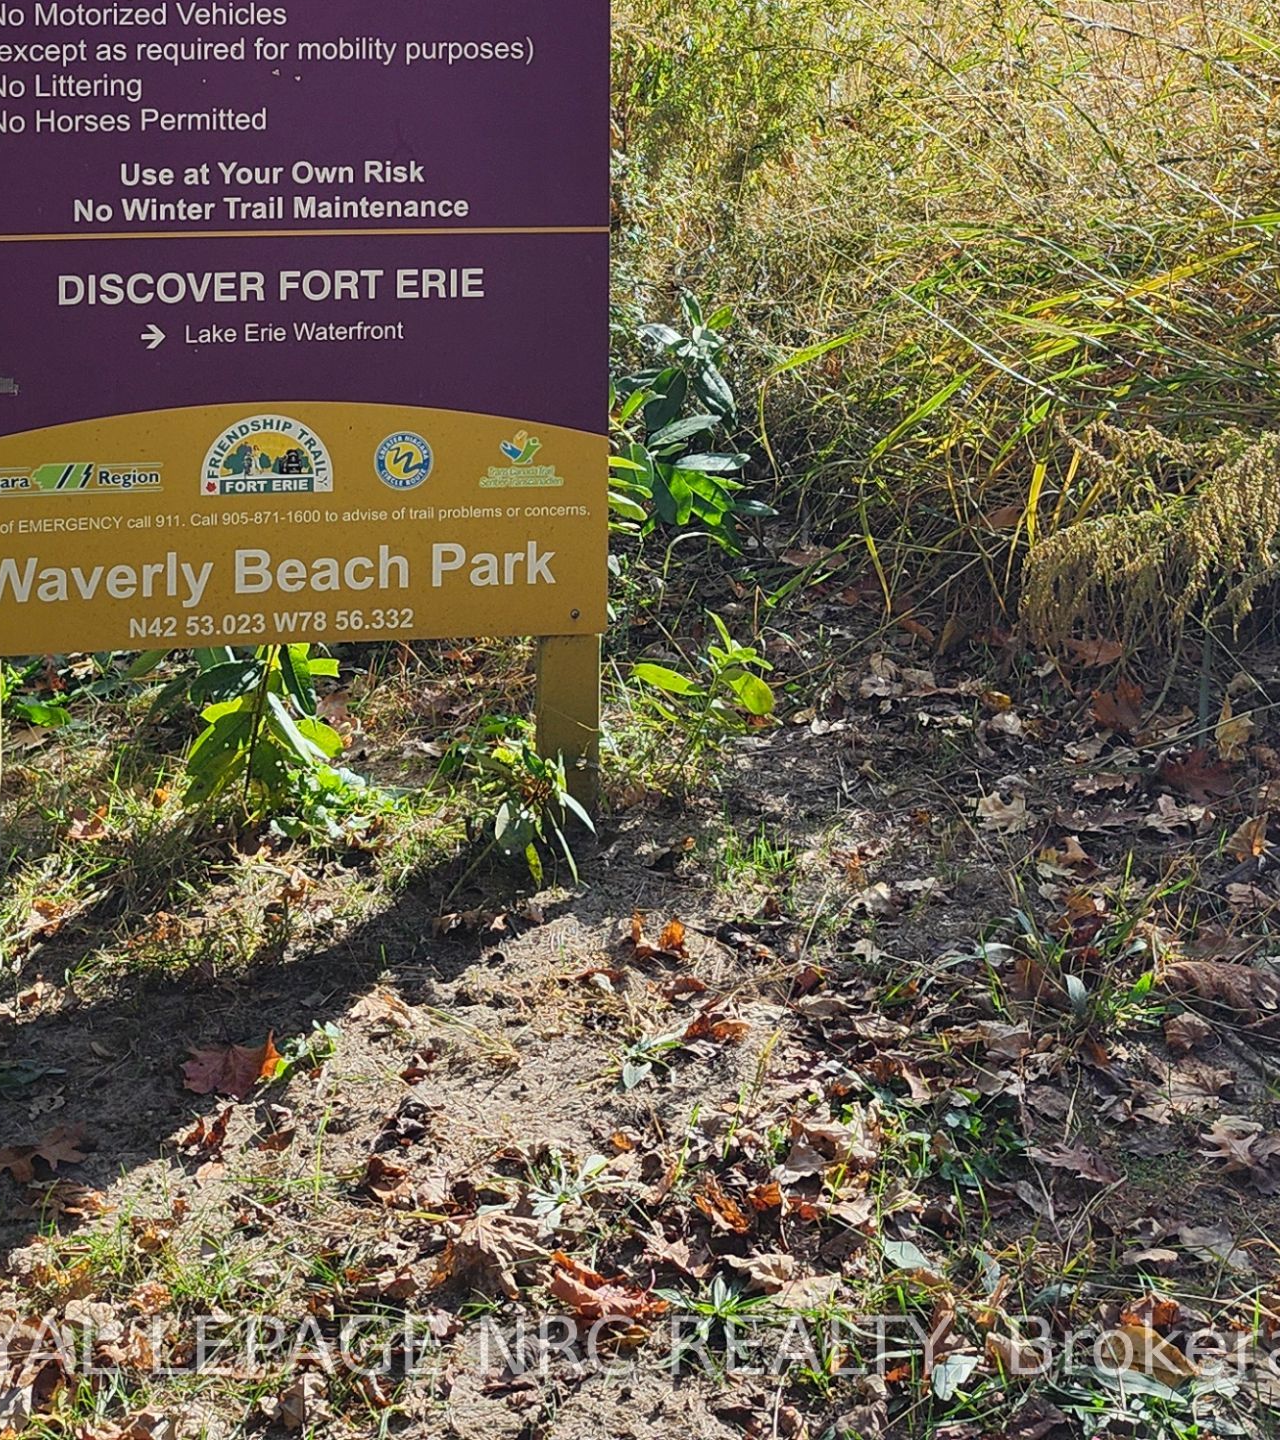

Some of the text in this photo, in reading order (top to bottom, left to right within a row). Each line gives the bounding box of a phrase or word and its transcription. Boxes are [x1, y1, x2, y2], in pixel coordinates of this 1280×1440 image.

[35, 2, 167, 26] Motorized
[175, 2, 287, 25] Vehicles
[95, 43, 127, 61] as
[137, 37, 245, 66] required
[253, 37, 290, 60] for
[298, 37, 397, 66] mobility
[406, 36, 534, 65] purposes)
[35, 73, 142, 103] Littering
[36, 109, 131, 133] Horses
[141, 107, 267, 131] Permitted
[121, 160, 425, 186] Use at Your Own Risk
[74, 195, 469, 222] No Winter Trail Maintenance
[58, 268, 485, 306] DISCOVER FORT ERIE
[185, 321, 404, 344] Lake Erie Waterfront
[207, 418, 327, 479] FRIENDSHIP TRAIL
[97, 469, 160, 488] Region
[225, 479, 309, 493] FORT ERIE
[0, 519, 15, 535] of
[18, 515, 124, 534] EMERGENCY
[126, 515, 151, 529] call
[155, 514, 186, 528] 911.
[190, 513, 218, 527] Call
[221, 509, 321, 526] 905-871-1600
[325, 510, 339, 522] to
[342, 508, 388, 522] advise
[391, 506, 406, 521] of
[409, 506, 435, 520] trail
[438, 505, 503, 522] problems
[505, 507, 521, 518] or
[524, 505, 591, 517] concerns.
[234, 544, 409, 594] Beach
[431, 540, 556, 587] Park
[129, 607, 414, 639] N42 53.023 W78 56.332
